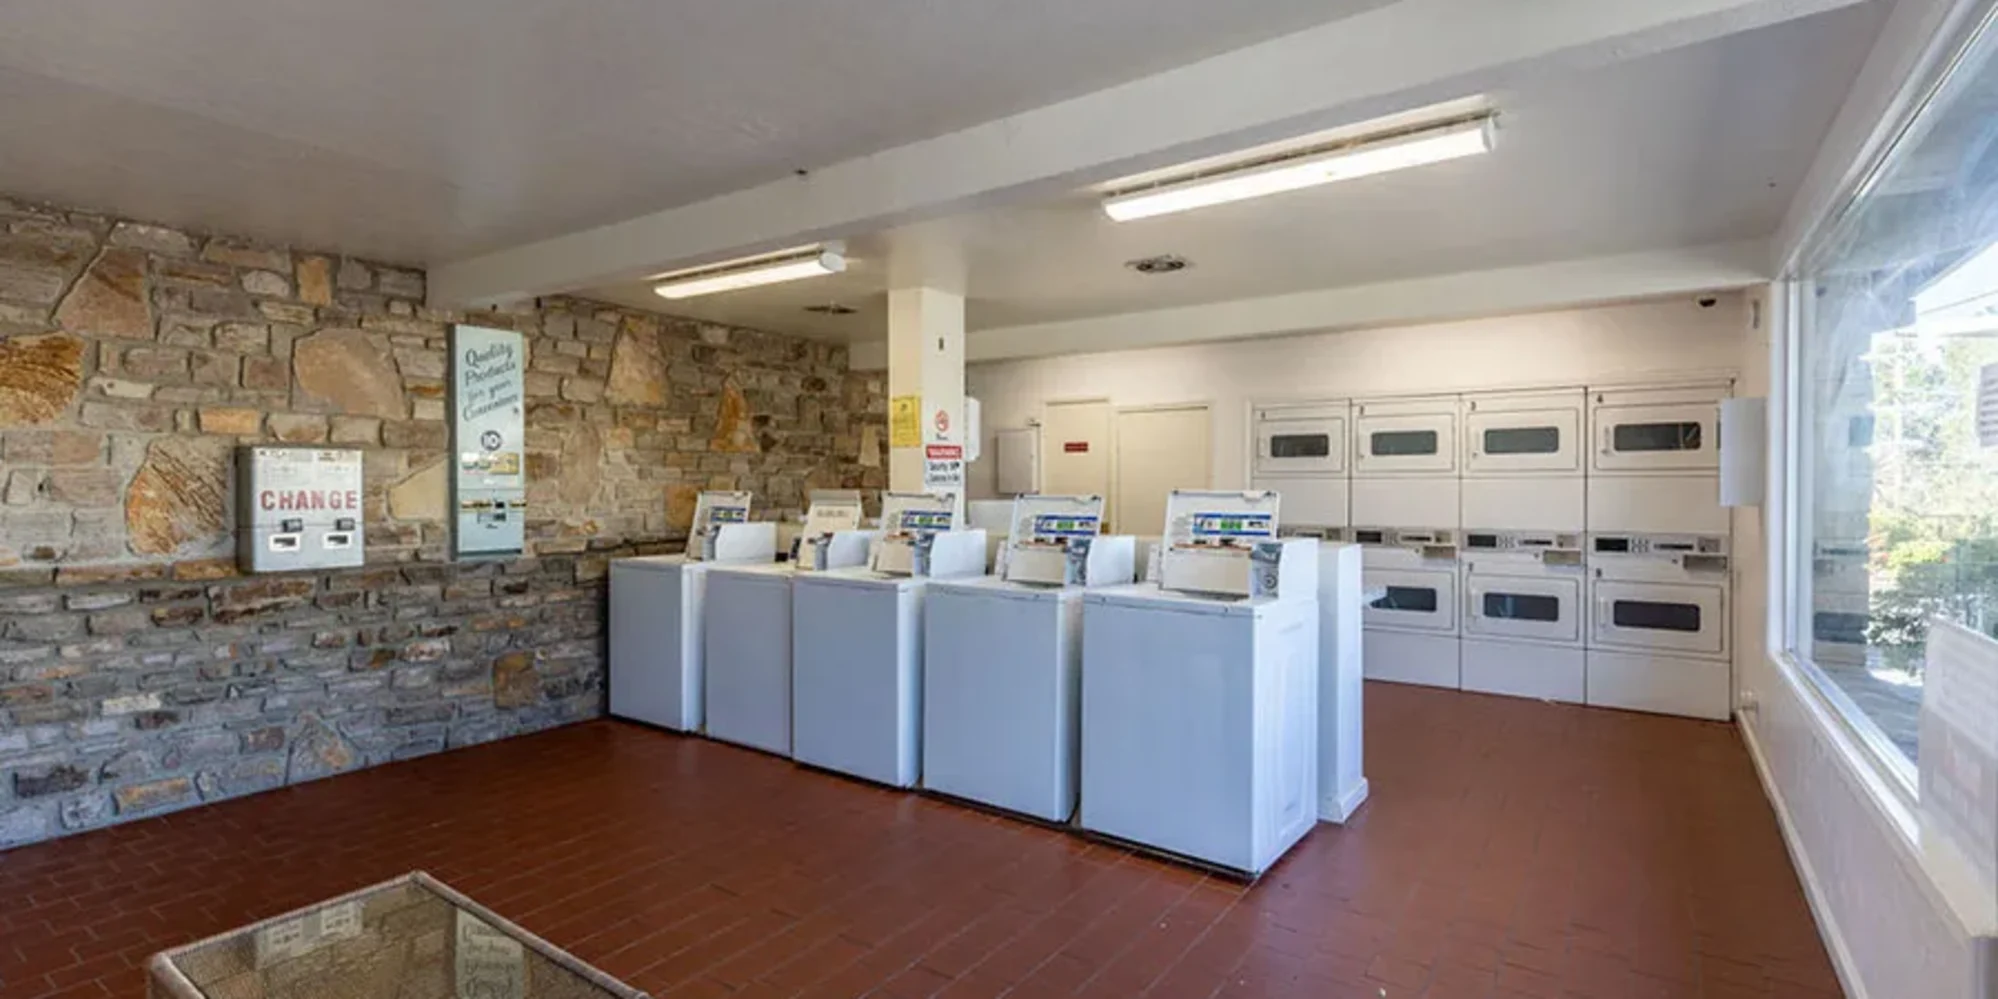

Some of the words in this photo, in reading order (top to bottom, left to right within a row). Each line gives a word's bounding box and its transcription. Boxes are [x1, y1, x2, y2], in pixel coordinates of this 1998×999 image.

[465, 343, 514, 369] Quality
[465, 361, 516, 387] Products
[260, 489, 358, 511] CHANGE
